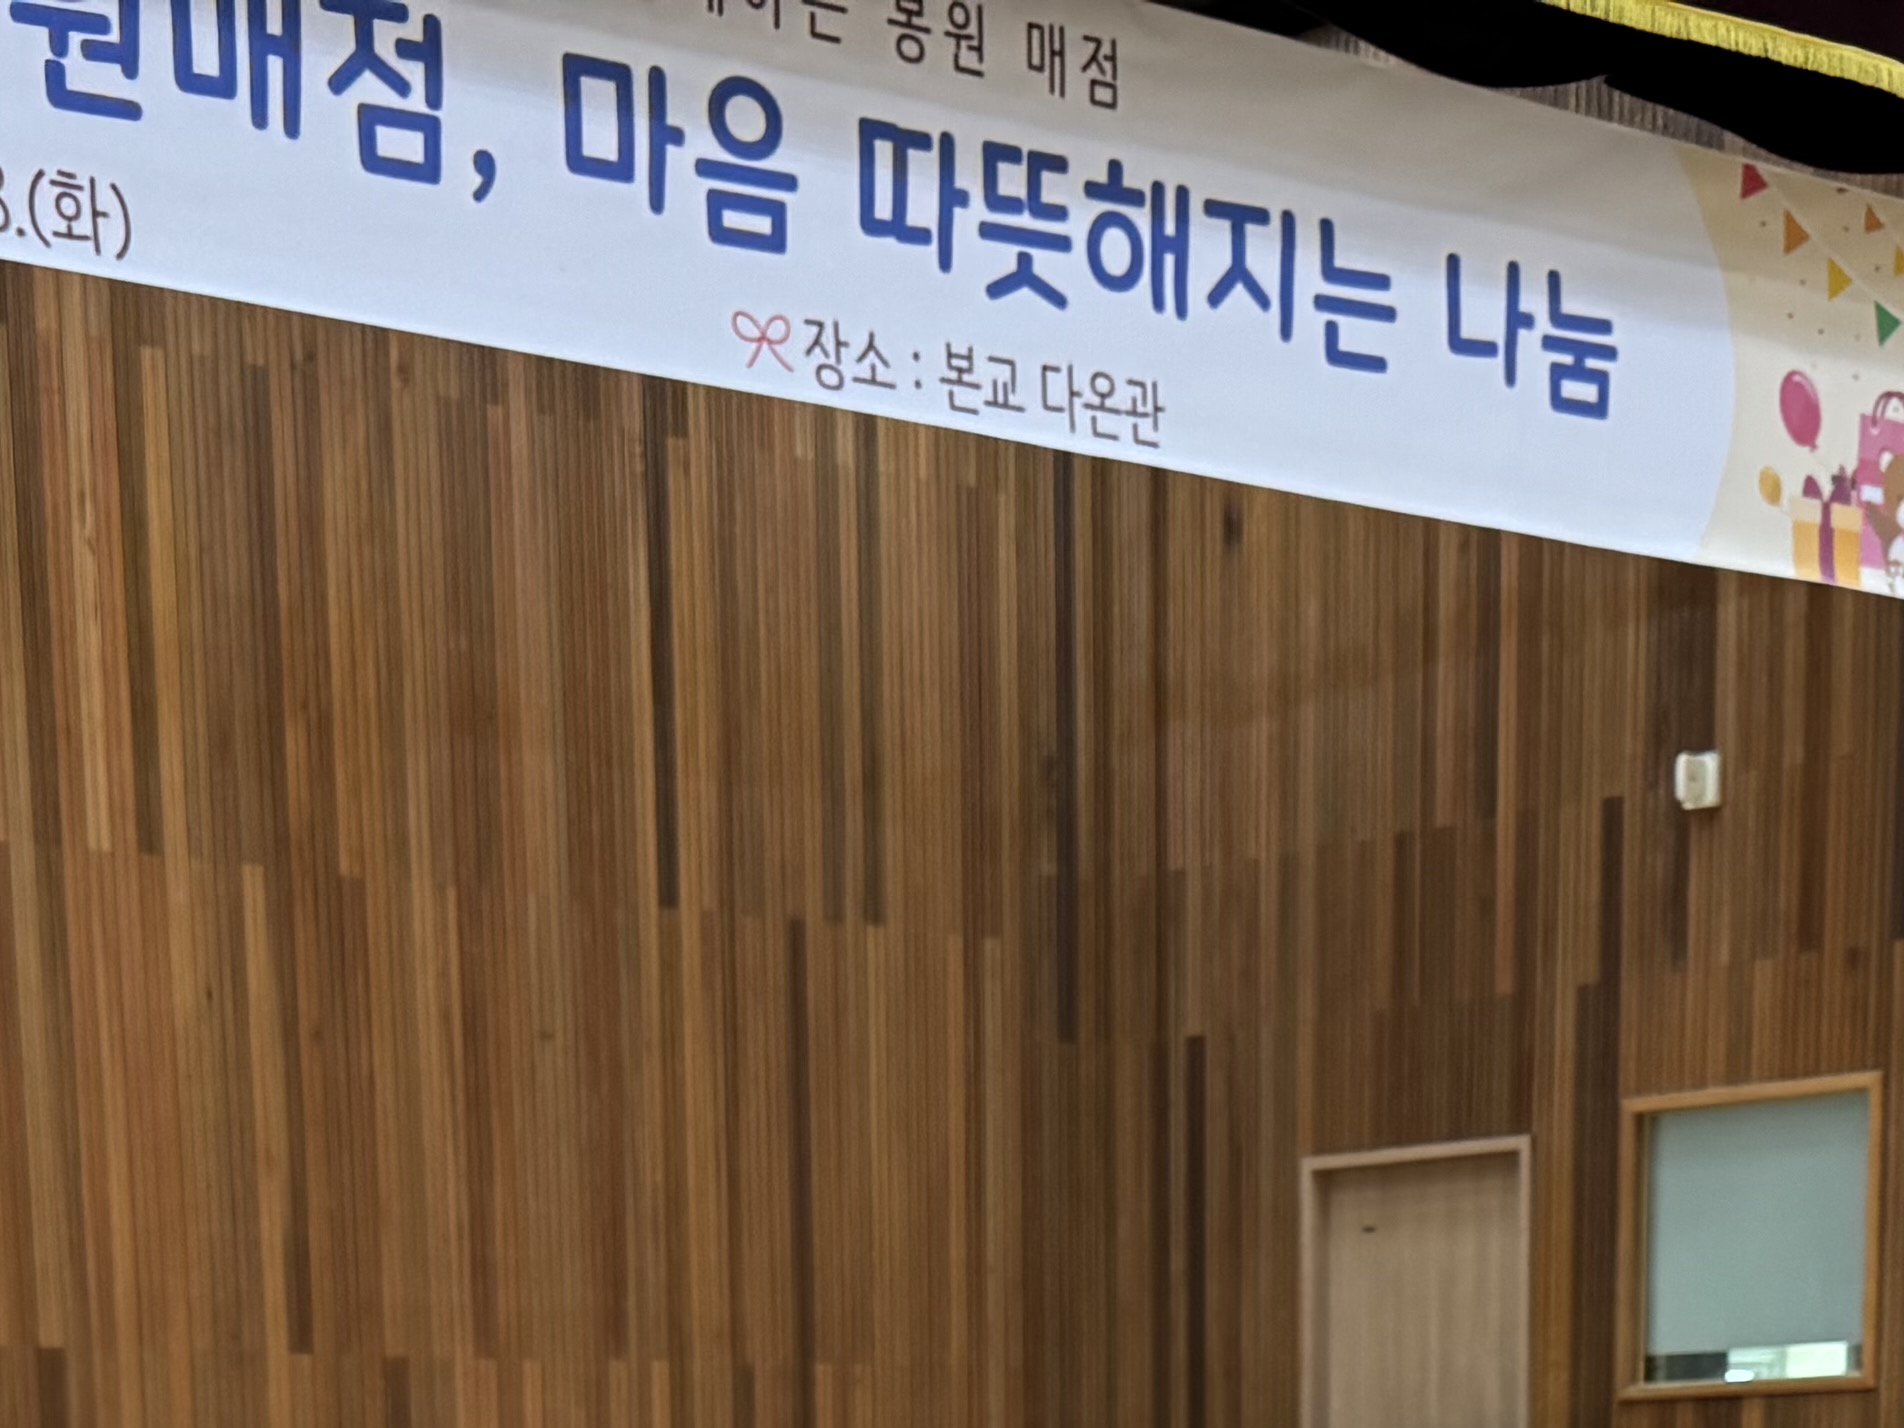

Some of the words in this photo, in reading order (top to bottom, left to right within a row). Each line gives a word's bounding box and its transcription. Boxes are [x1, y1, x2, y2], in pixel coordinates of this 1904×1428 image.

[1026, 20, 1119, 111] 매점
[562, 52, 798, 256] 마음
[857, 116, 1397, 374] 따뜻해지는
[1446, 252, 1619, 421] 나눔
[803, 318, 897, 391] 장소
[938, 341, 1027, 416] 본교
[1040, 362, 1166, 449] 다온관
